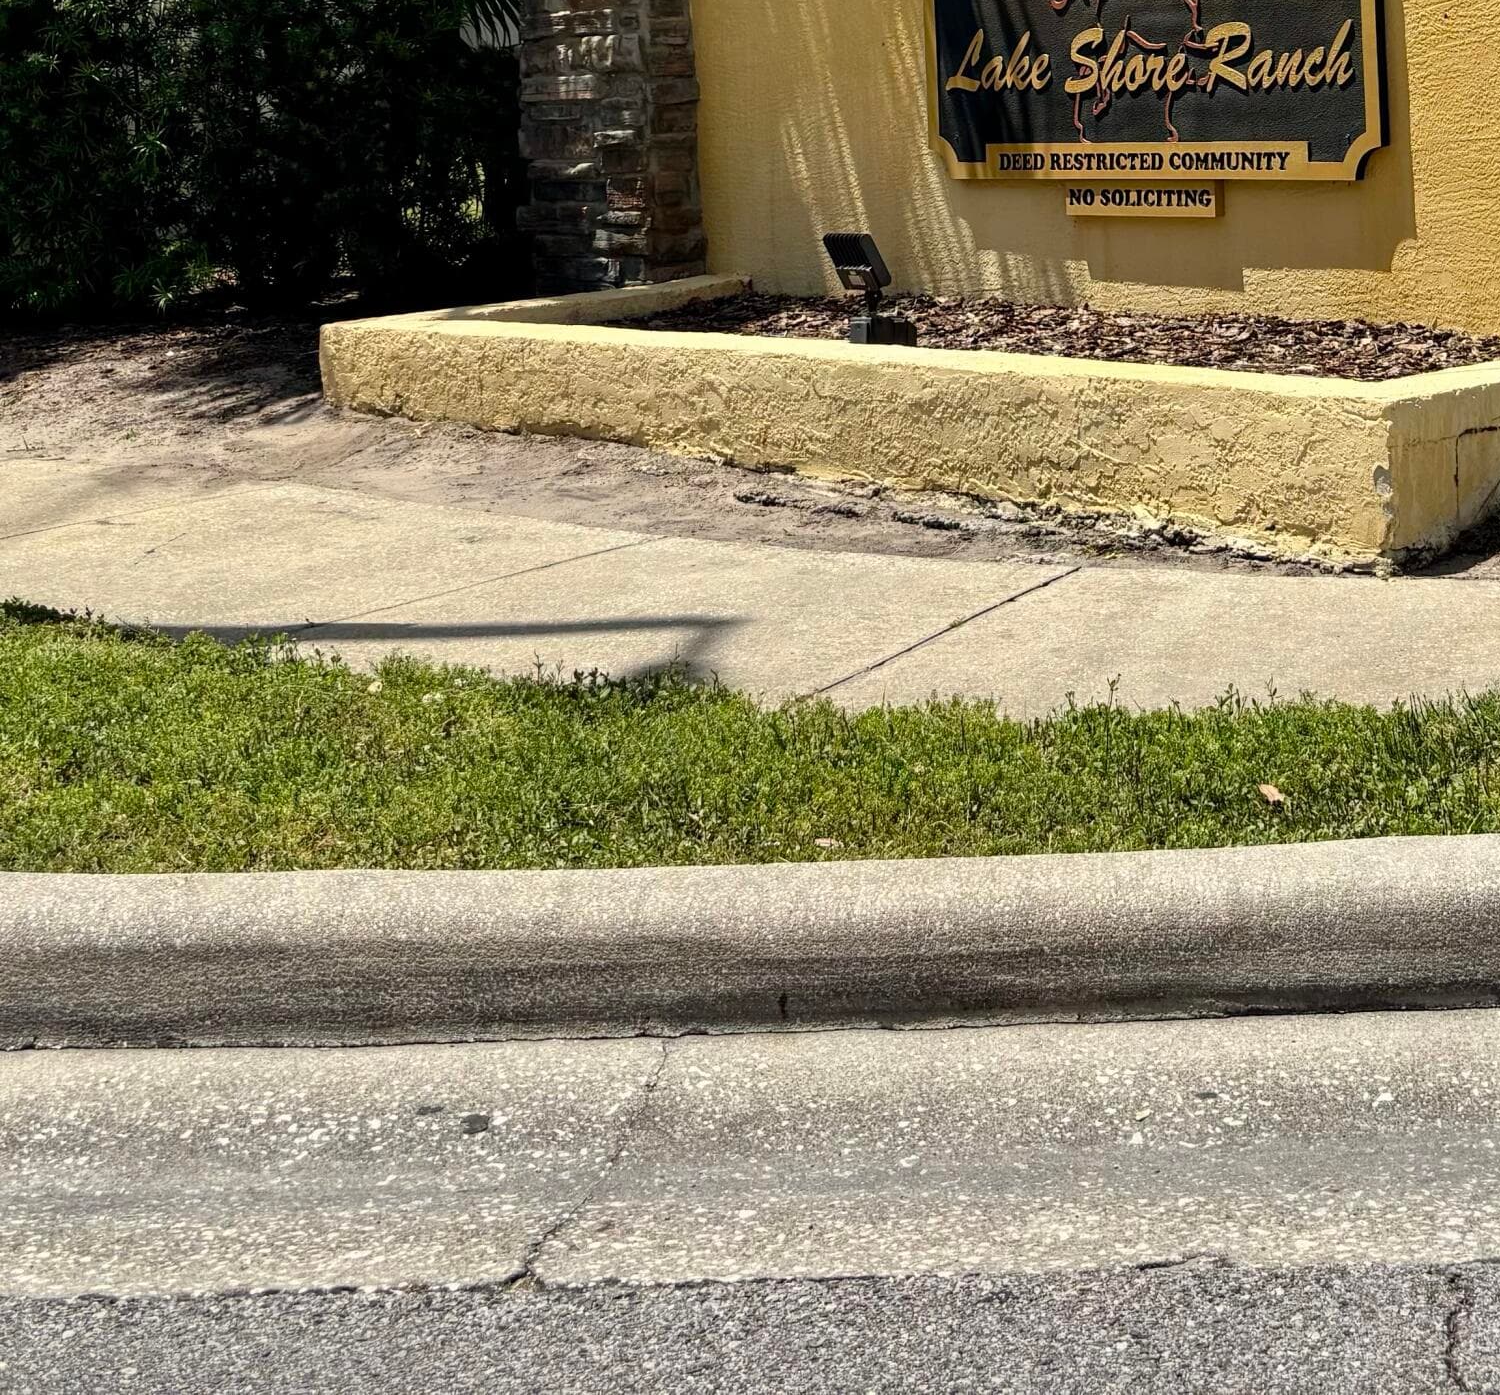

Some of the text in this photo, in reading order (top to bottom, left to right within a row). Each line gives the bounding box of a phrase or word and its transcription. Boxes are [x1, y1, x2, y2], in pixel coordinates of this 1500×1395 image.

[945, 19, 1354, 94] Lake Shore Ranch
[999, 152, 1290, 171] DEED RESTRICTED COMMUNITY
[1069, 188, 1213, 207] NO SOLICITING
